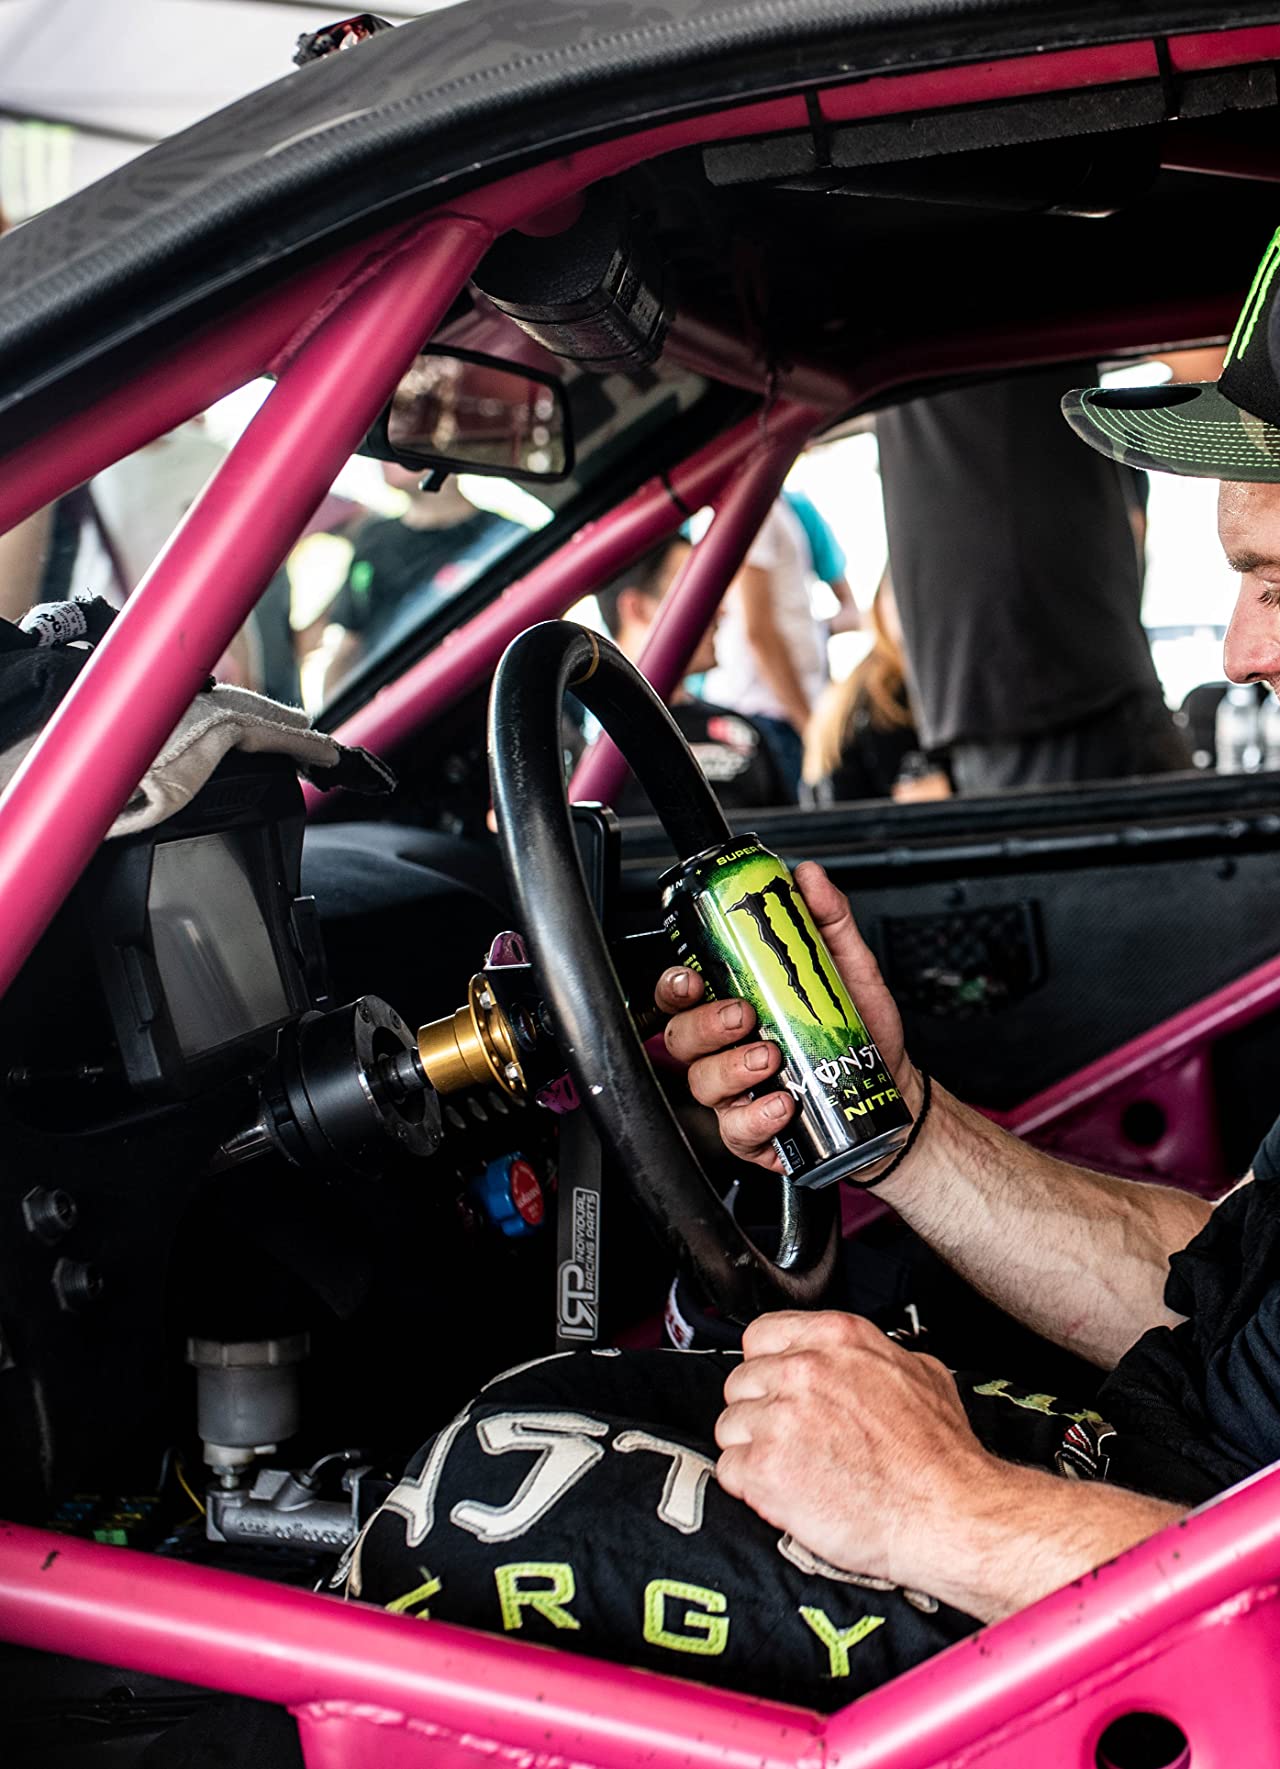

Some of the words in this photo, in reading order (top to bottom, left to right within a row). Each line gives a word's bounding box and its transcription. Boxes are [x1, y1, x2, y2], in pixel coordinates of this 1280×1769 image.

[843, 1087, 902, 1122] NITR
[575, 1192, 587, 1263] INDIVIDUAL
[585, 1193, 597, 1240] PARTS
[584, 1241, 596, 1291] RACING
